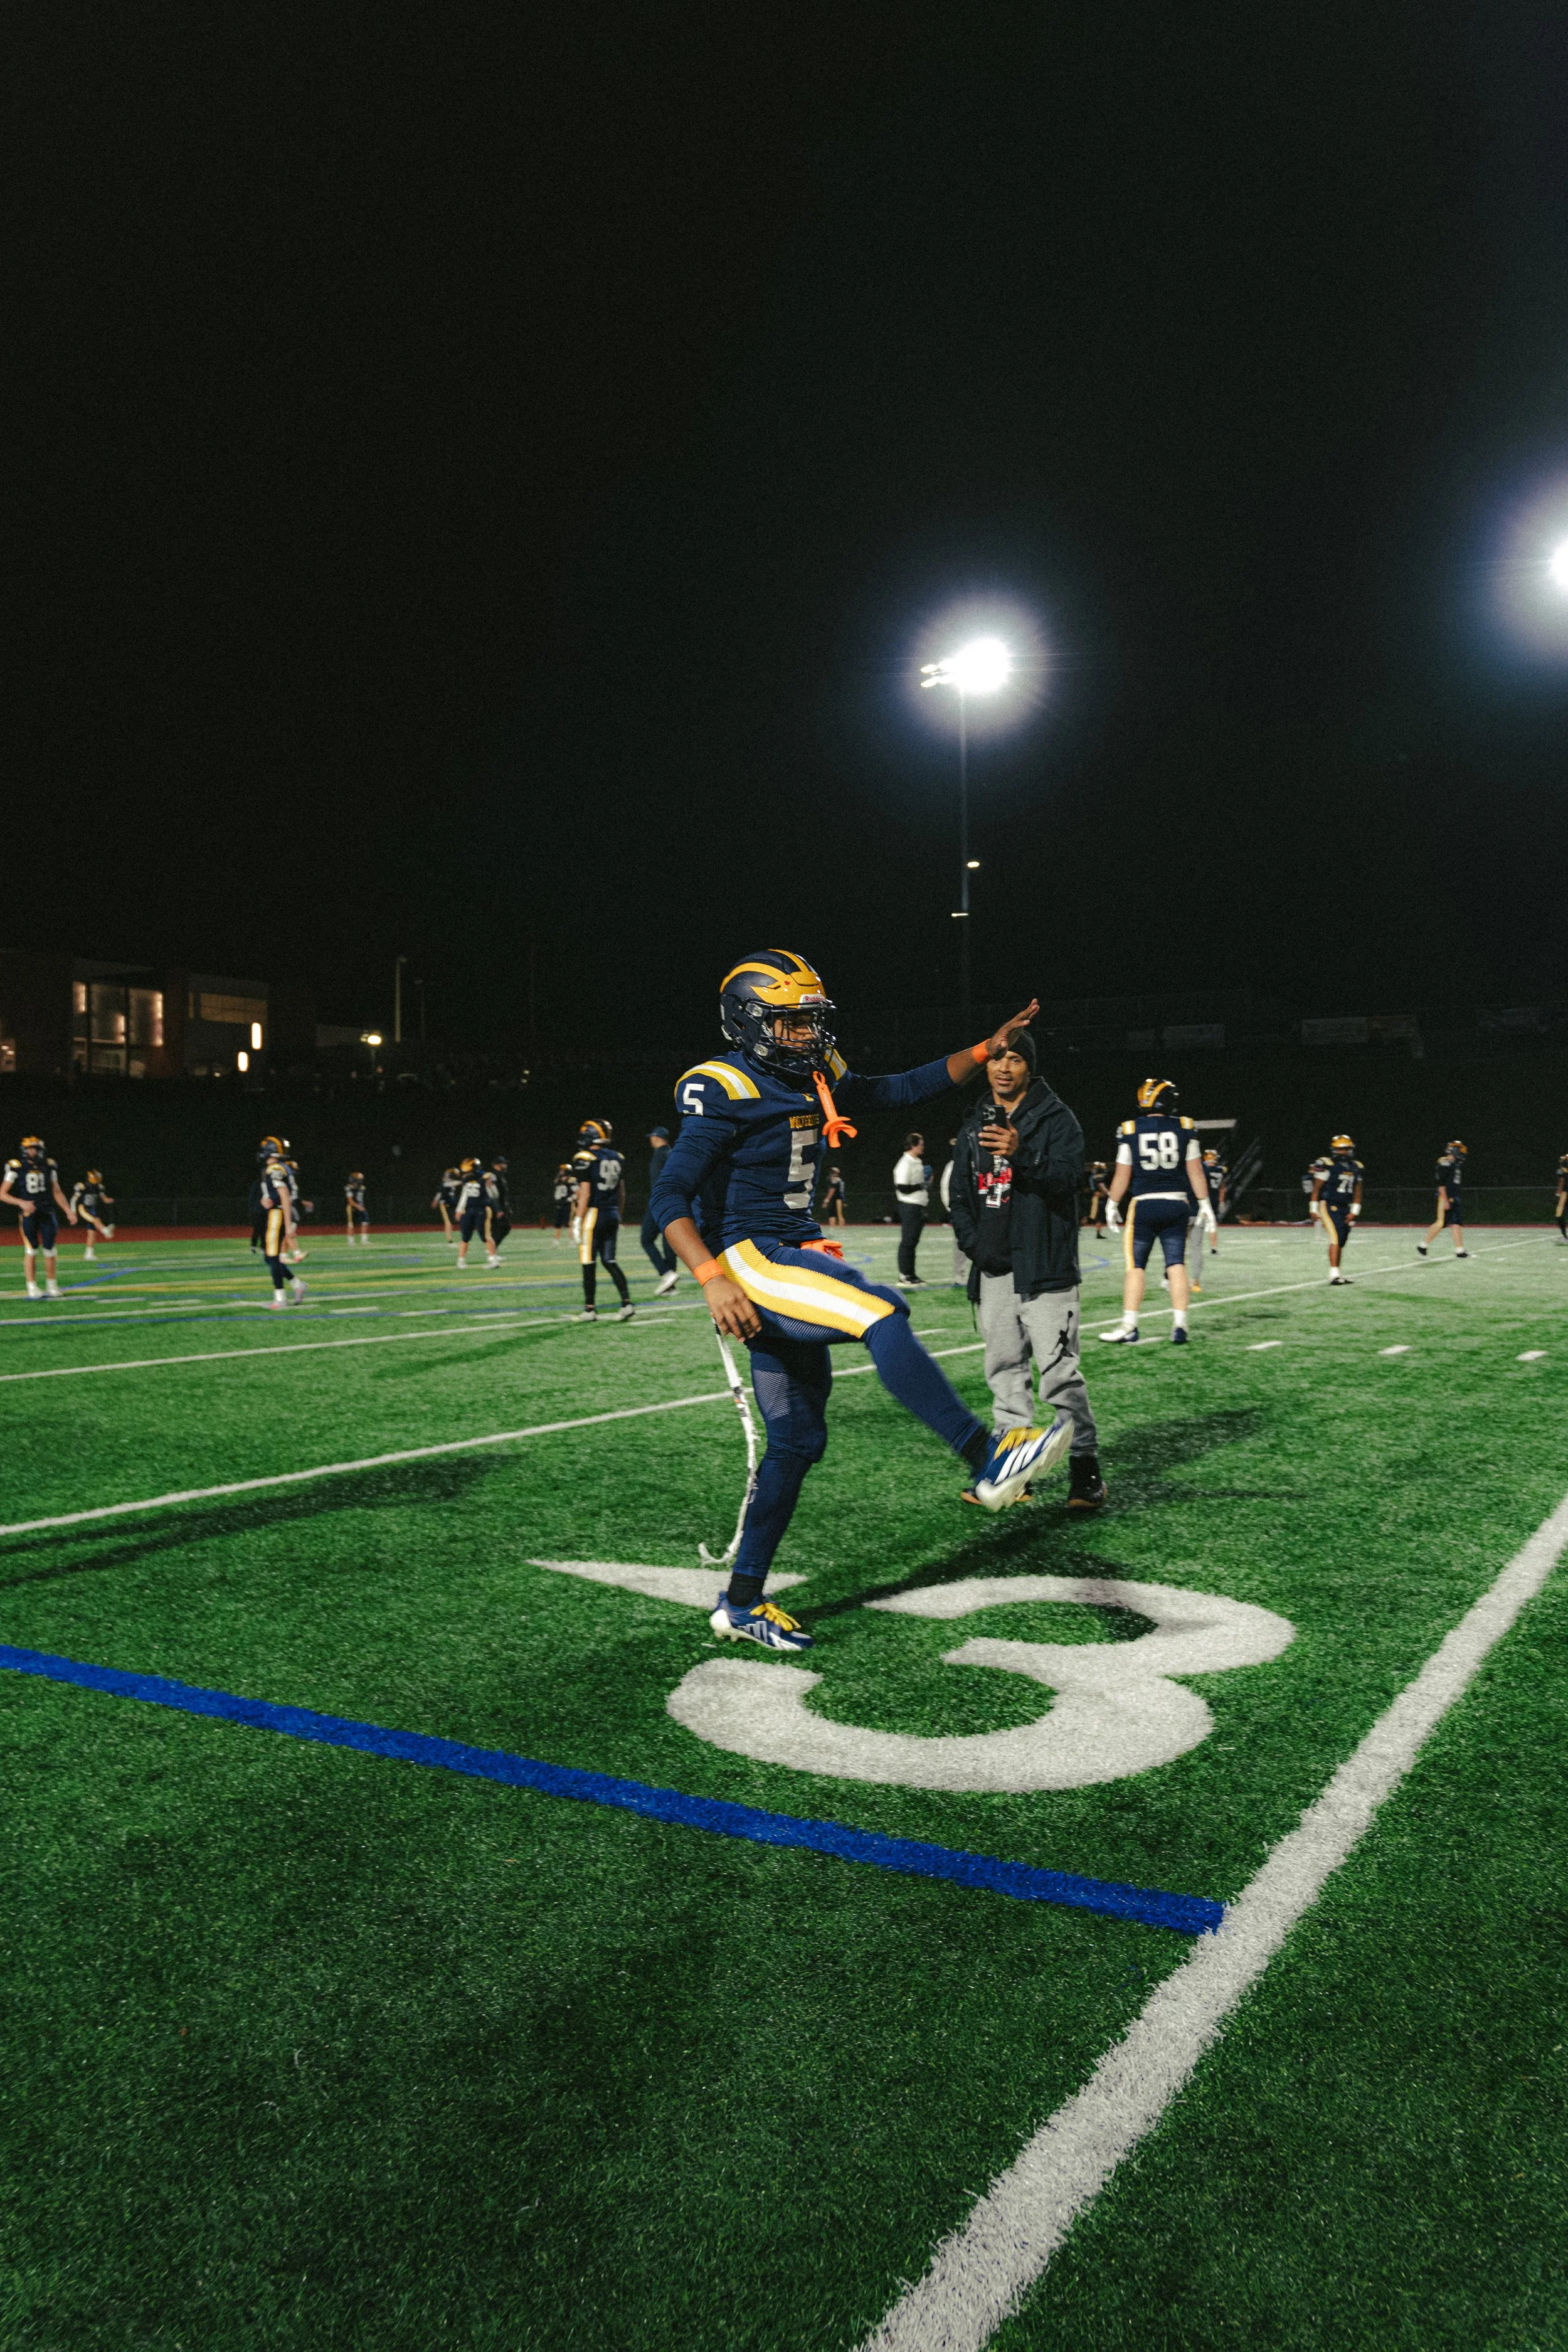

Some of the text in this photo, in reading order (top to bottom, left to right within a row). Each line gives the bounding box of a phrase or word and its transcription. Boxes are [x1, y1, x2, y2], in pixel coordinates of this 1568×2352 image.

[682, 1083, 705, 1116] 5
[783, 1128, 818, 1209] 5
[1138, 1131, 1179, 1170] 58
[26, 1172, 46, 1194] 81
[666, 1575, 1296, 1793] 3
